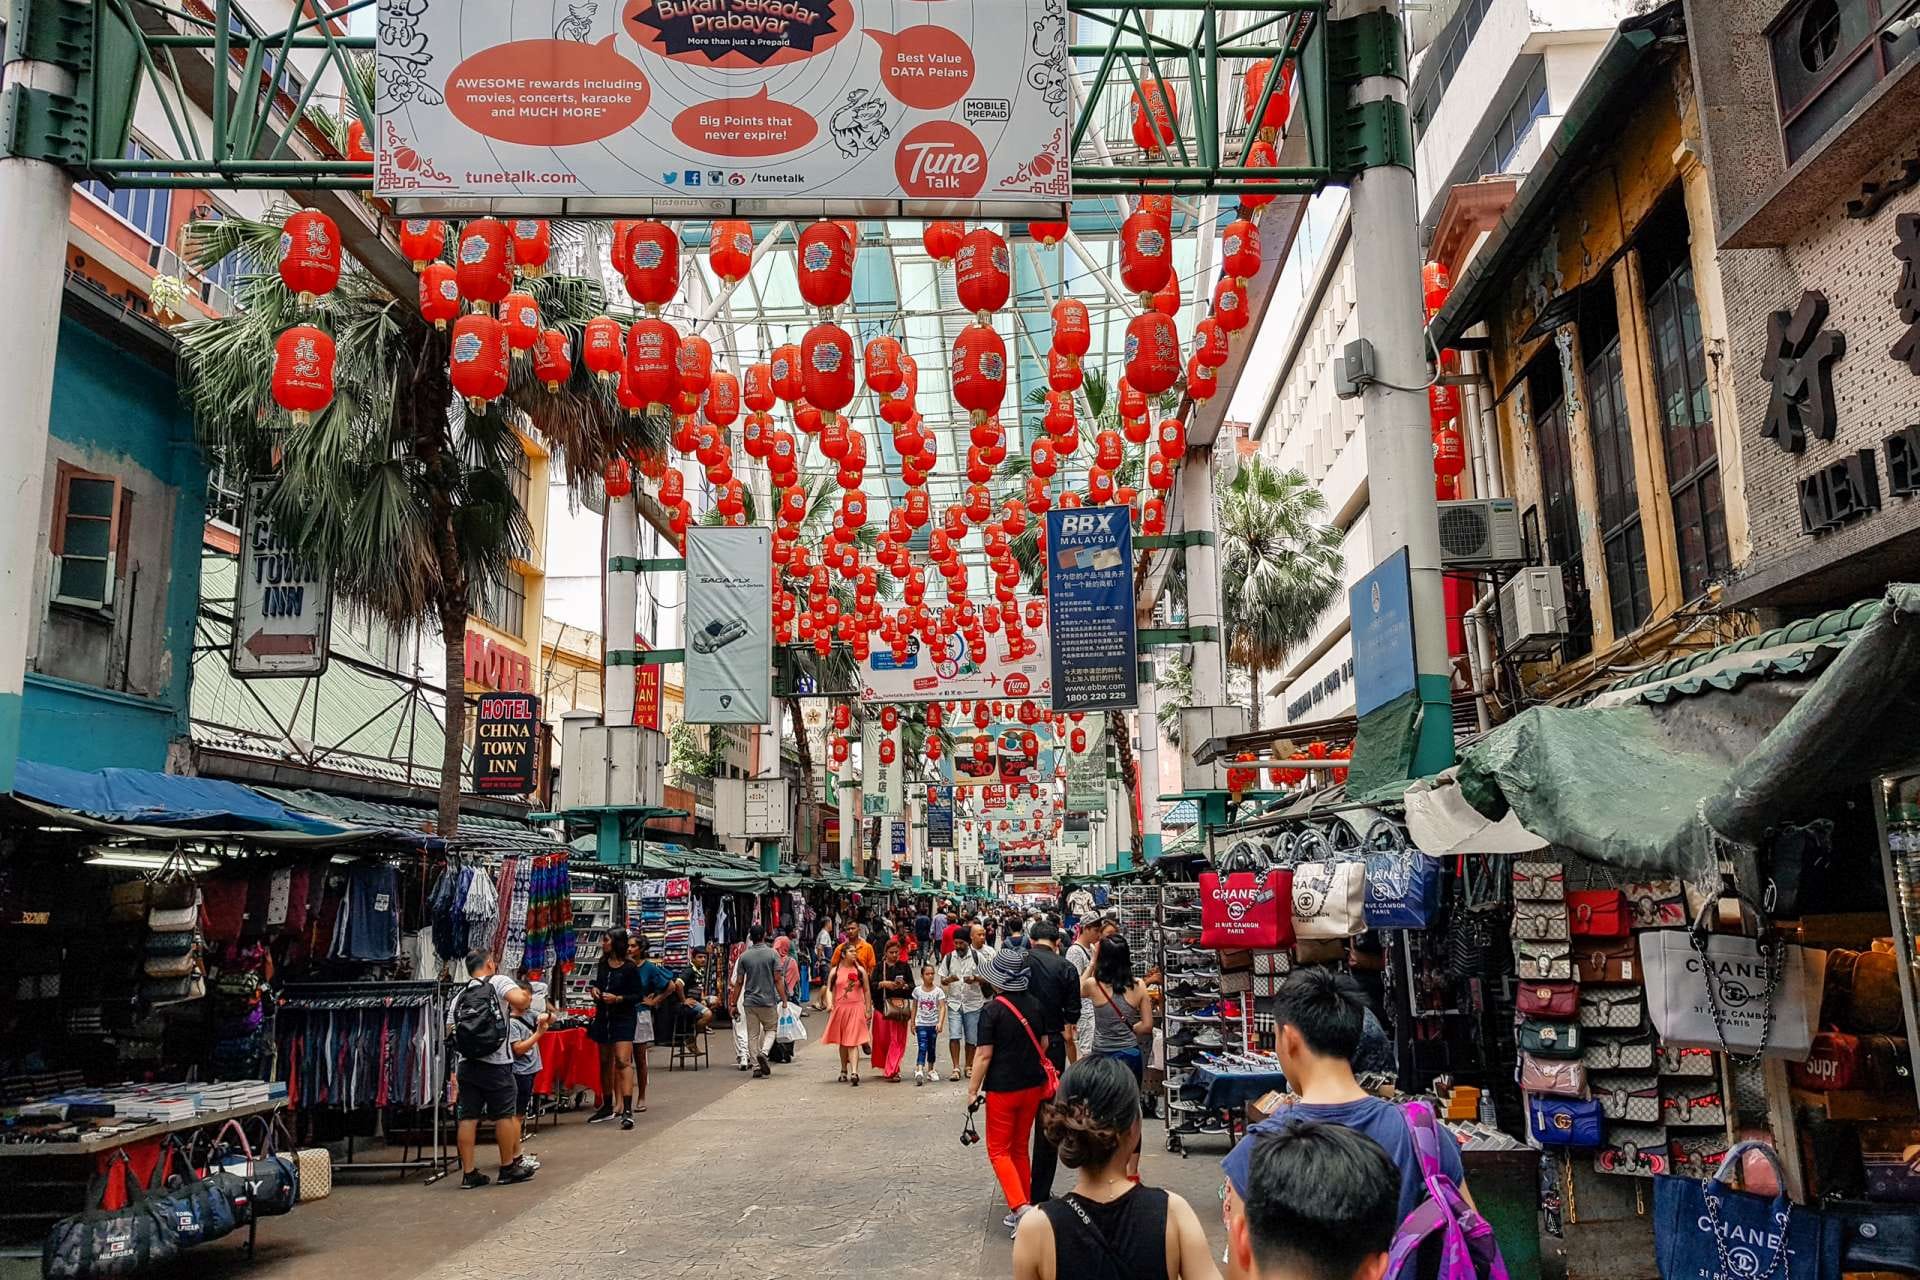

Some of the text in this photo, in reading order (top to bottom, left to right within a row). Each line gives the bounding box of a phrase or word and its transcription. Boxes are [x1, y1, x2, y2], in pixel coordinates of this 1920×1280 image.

[657, 0, 820, 25] Bukan Sekadar
[692, 11, 790, 34] Prabayar
[687, 37, 709, 45] More
[711, 37, 730, 45] than
[732, 38, 748, 46] just
[757, 38, 790, 47] Prepaid
[897, 53, 962, 63] Best Value
[891, 67, 968, 78] DATA Pelans
[456, 78, 642, 91] AWESOME rewards including
[466, 92, 632, 105] movies, concerts, karaoke
[491, 107, 515, 118] and
[519, 107, 558, 118] MUCH
[967, 102, 1006, 111] MOBILE
[967, 110, 1008, 119] PREPAID
[699, 116, 792, 127] Big Points that
[705, 130, 787, 142] never expire!
[905, 143, 981, 184] Tune
[466, 170, 577, 185] tunetalk.com
[751, 172, 805, 184] /tunetalk
[926, 175, 961, 189] Talk
[1061, 513, 1114, 537] BBX
[1060, 535, 1116, 545] MALAYSIA
[254, 552, 320, 584] TOWN
[262, 586, 304, 617] INN
[464, 629, 530, 692] HOTEL
[1006, 679, 1028, 692] Tune
[1065, 682, 1126, 692] www.ebbx.com
[1066, 691, 1126, 702] 1800 220 229
[481, 699, 532, 720] HOTEL
[479, 723, 530, 738] CHINA
[481, 741, 527, 755] TOWN
[488, 759, 518, 773] INN
[1212, 888, 1257, 900] CHANE
[1731, 1010, 1777, 1022] CAMBN
[1720, 1019, 1750, 1027] PARIS
[1066, 1198, 1091, 1225] SONY
[106, 1234, 131, 1243] TOMMY
[98, 1249, 134, 1260] HILFIGER
[1698, 1268, 1709, 1278] 31
